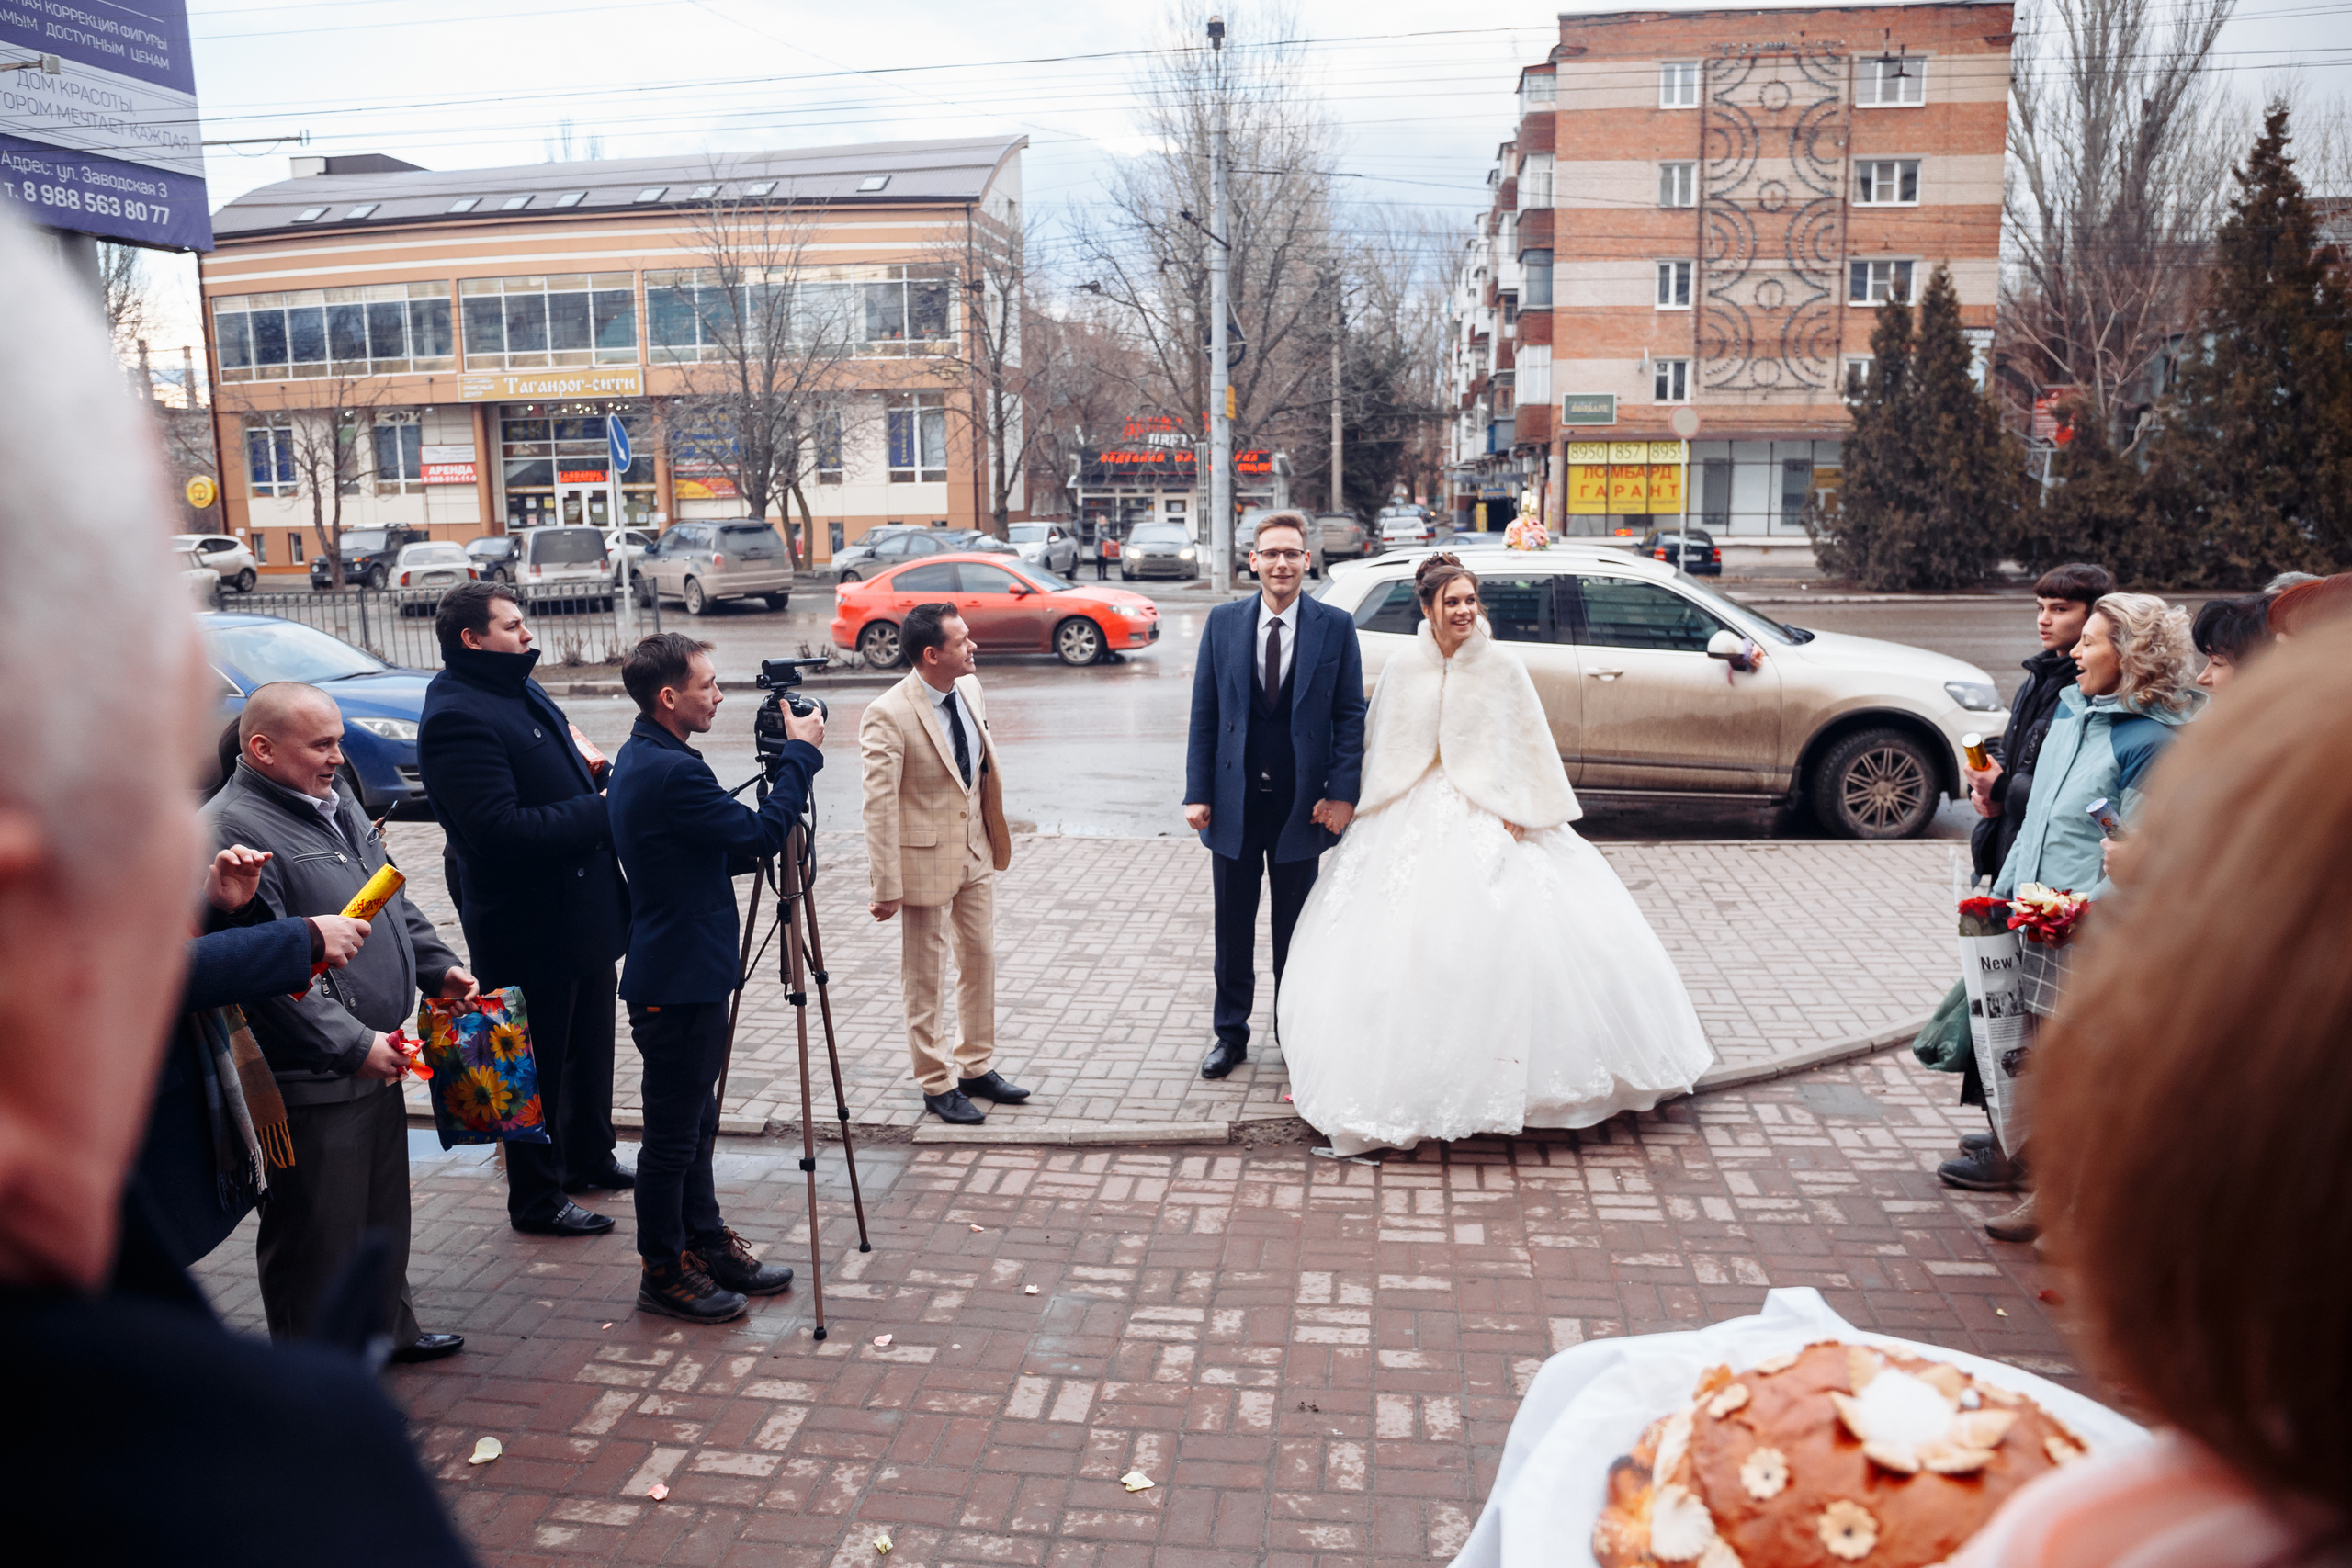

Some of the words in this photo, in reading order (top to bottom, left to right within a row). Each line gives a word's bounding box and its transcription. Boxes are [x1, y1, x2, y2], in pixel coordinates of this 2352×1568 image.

[44, 0, 119, 35] КОРРЕКЦИЯ
[120, 25, 168, 51] ФИГУРЫ
[46, 22, 125, 57] ДОСТУПНЫМ
[130, 47, 170, 71] ЦЕНАМ
[17, 69, 56, 94] ДОМ
[59, 79, 137, 117] КРАСОТЫ,
[0, 90, 53, 118] ОРОМ
[56, 104, 126, 136] МЕЧТАЕТ
[130, 123, 191, 152] КАЖДАЯ
[56, 164, 80, 183] ул.
[81, 165, 156, 197] Заводская
[157, 182, 169, 198] 3
[23, 180, 37, 202] 8
[40, 184, 81, 210] 988
[85, 191, 122, 217] 563
[124, 199, 148, 222] 80
[149, 203, 171, 226] 77
[1570, 444, 1605, 459] 8950
[1614, 444, 1642, 459] 857
[428, 464, 474, 476] АРЕНДА
[1583, 466, 1673, 480] ЛОМБАРД
[1579, 484, 1679, 498] ГАРАНТ
[1980, 955, 2013, 971] New
